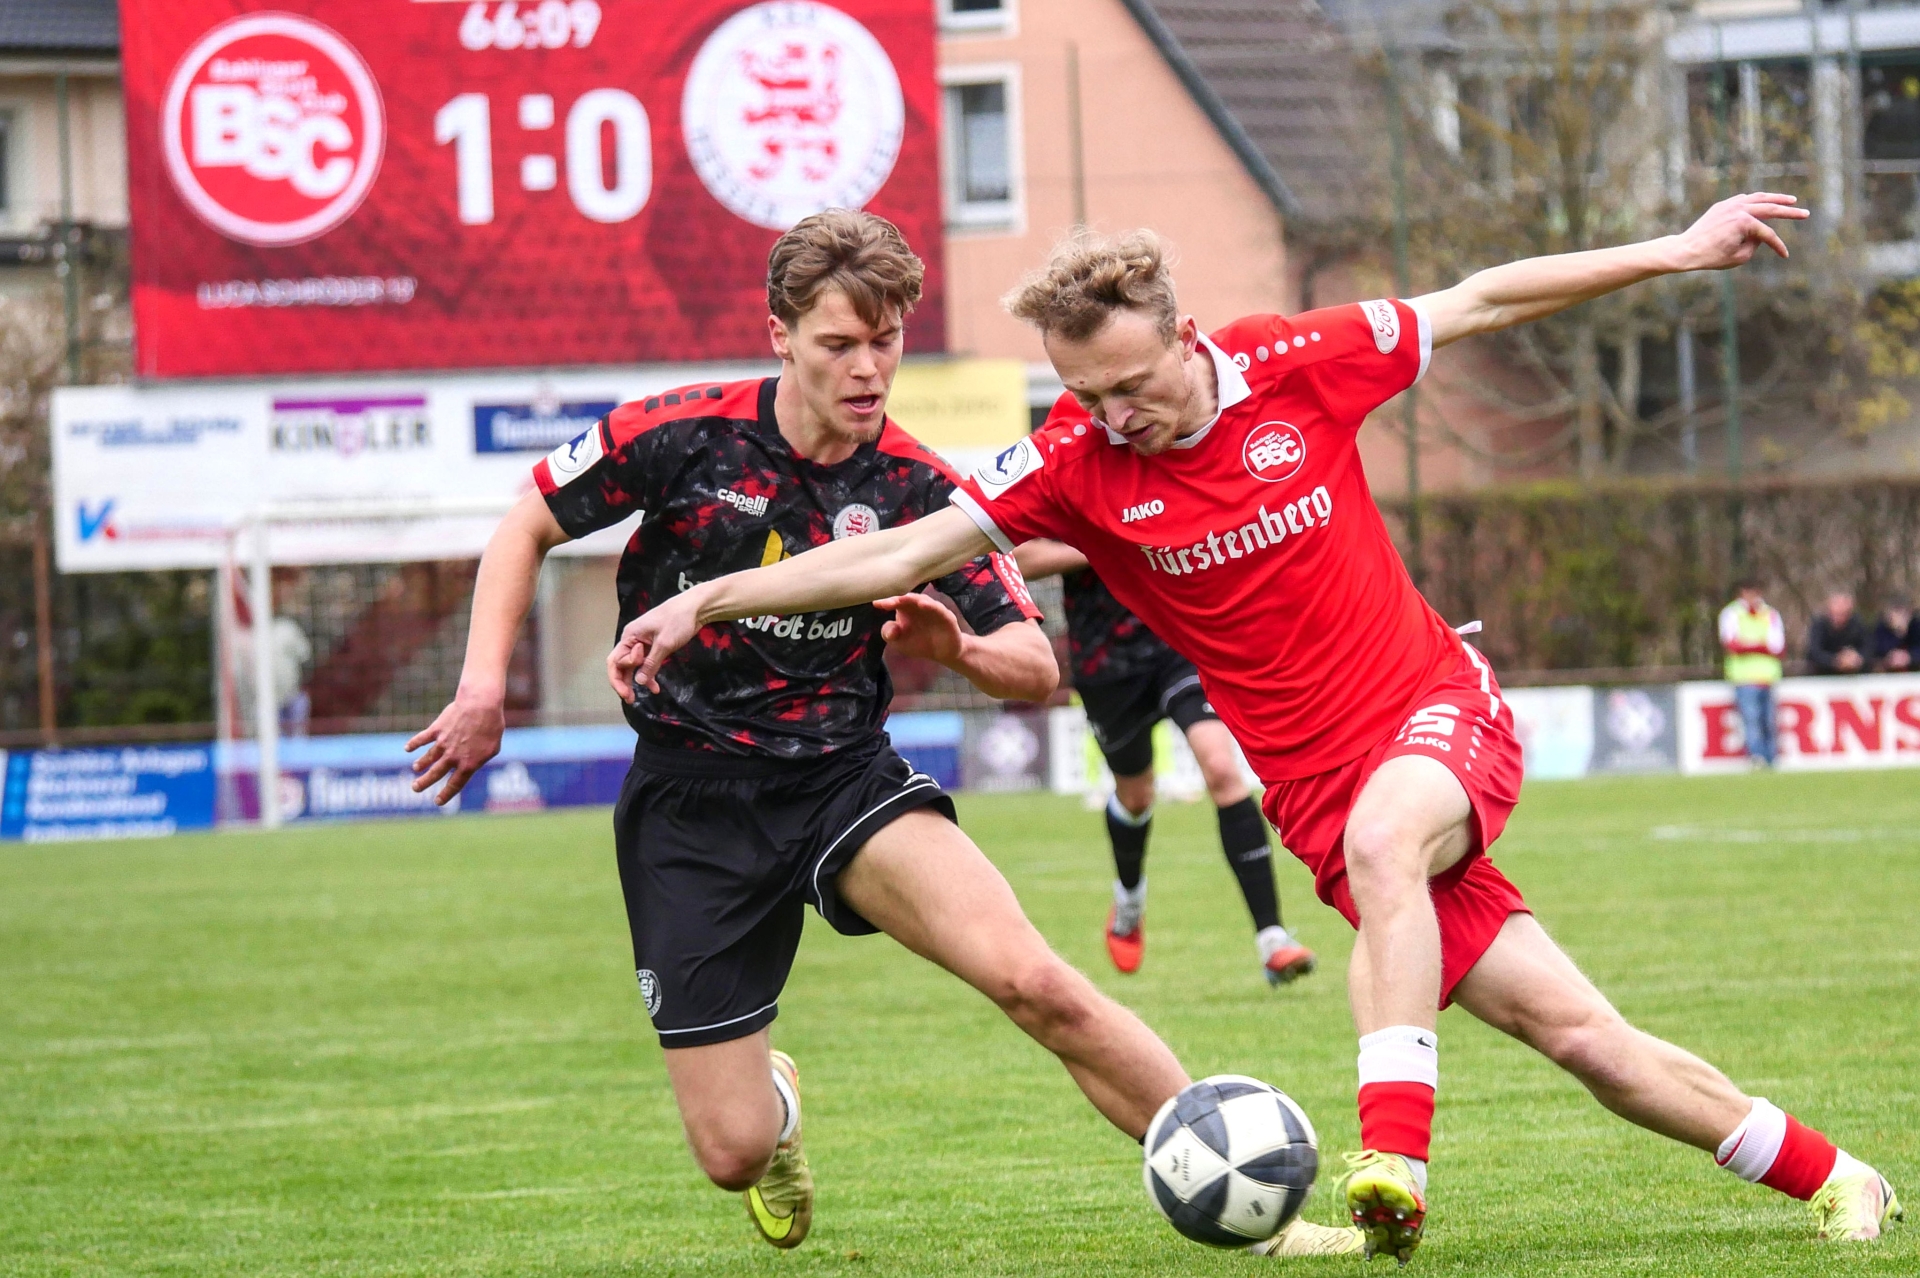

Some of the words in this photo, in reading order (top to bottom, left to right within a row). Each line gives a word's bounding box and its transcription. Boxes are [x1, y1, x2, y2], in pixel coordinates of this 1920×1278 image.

[458, 1, 602, 51] 66:09
[190, 82, 355, 199] BSC
[1247, 439, 1301, 472] BSC
[716, 488, 769, 513] capelli
[738, 505, 765, 518] SPORT
[1121, 499, 1165, 524] JAKO
[807, 615, 852, 641] bau
[1403, 735, 1452, 752] JAKO
